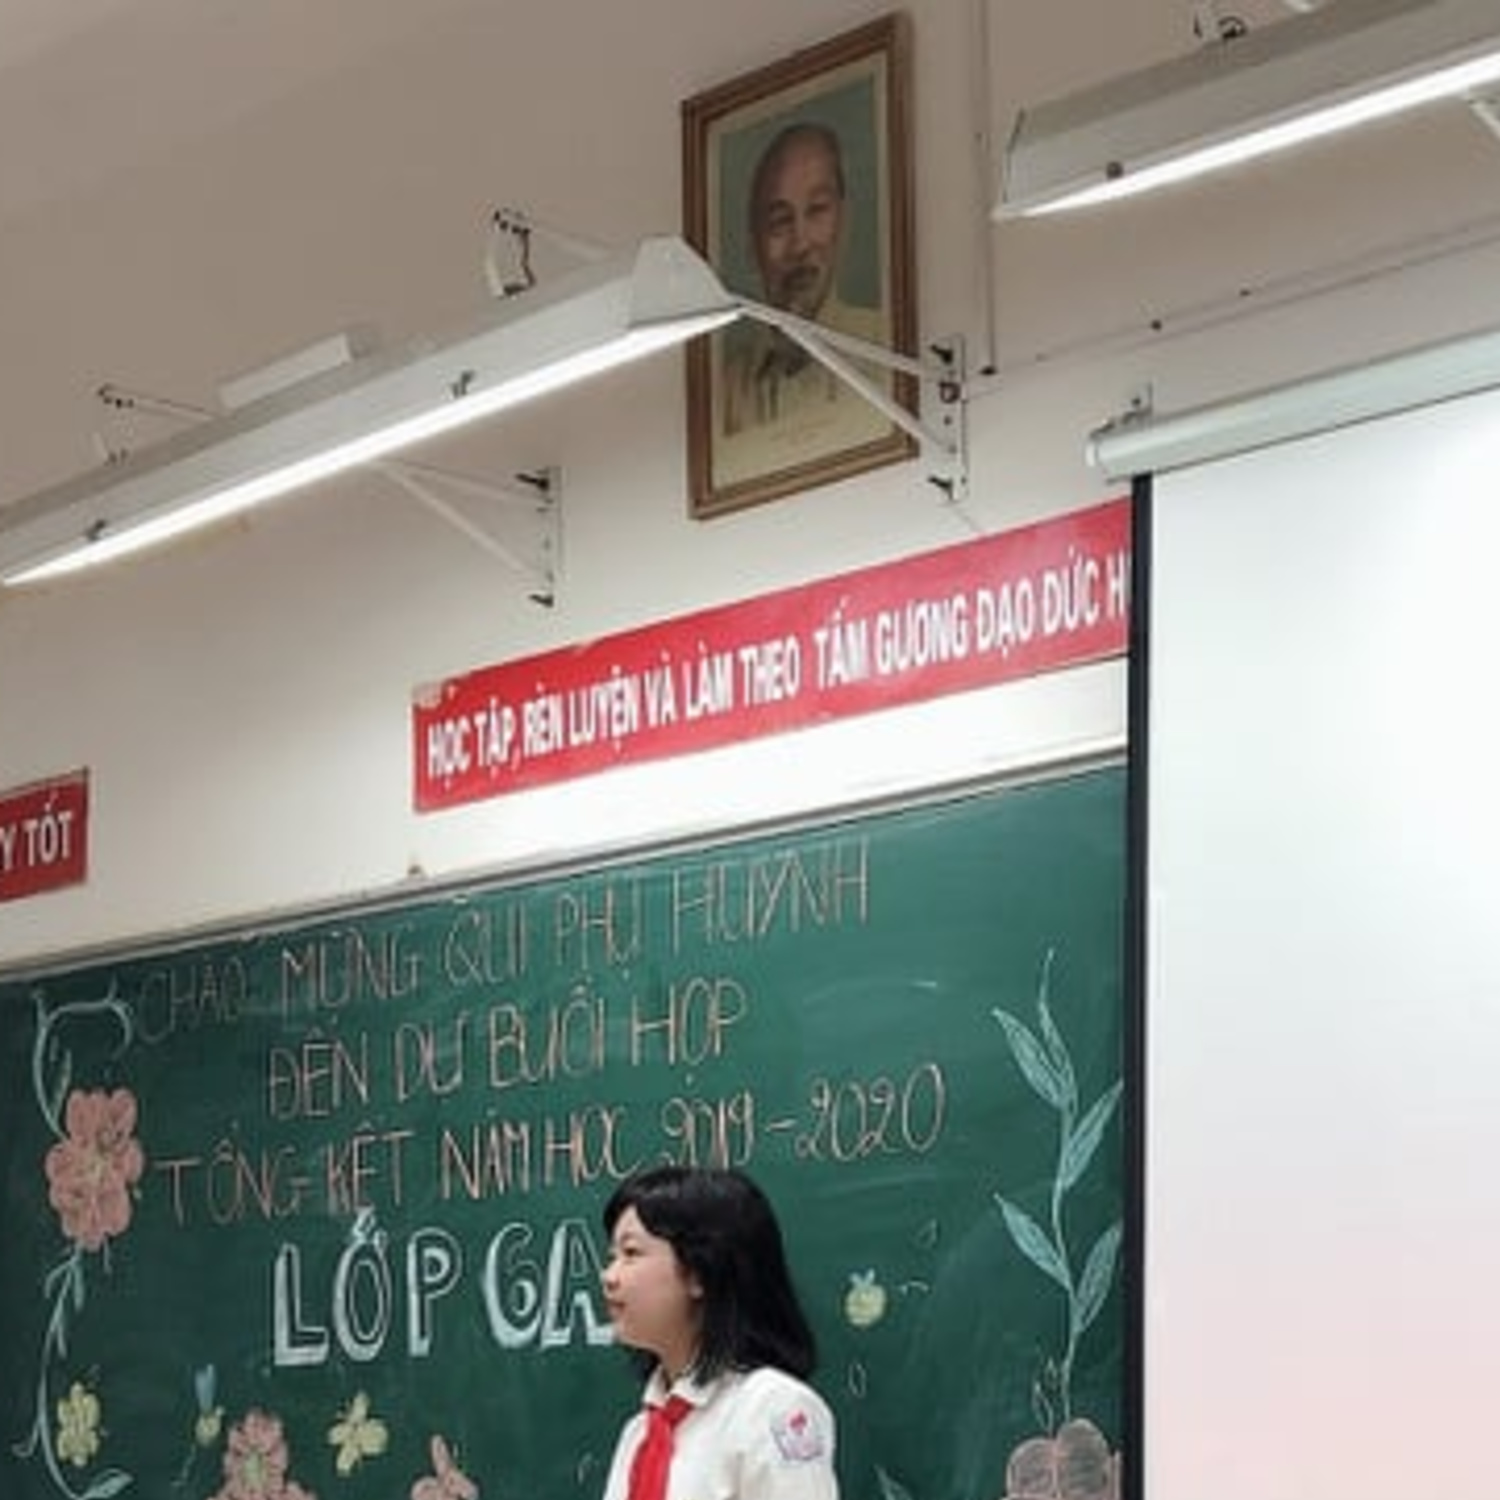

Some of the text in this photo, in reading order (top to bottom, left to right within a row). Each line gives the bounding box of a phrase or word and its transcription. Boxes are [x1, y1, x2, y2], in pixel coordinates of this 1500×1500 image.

[682, 639, 734, 720] LÀM
[739, 634, 801, 706] THEO
[813, 595, 869, 692] TẤM
[22, 788, 72, 867] TỐT
[632, 976, 746, 1086] HỌP
